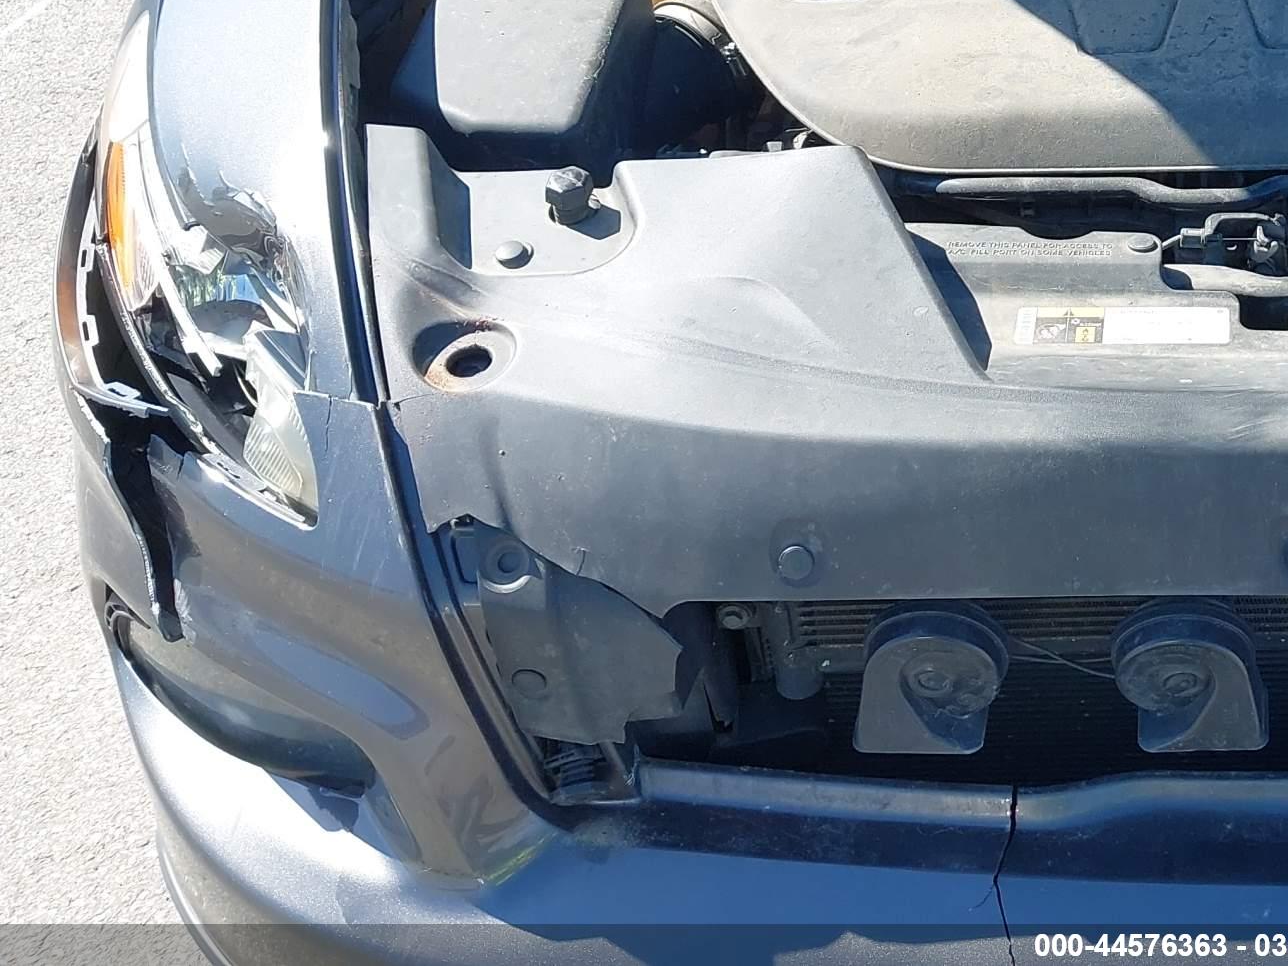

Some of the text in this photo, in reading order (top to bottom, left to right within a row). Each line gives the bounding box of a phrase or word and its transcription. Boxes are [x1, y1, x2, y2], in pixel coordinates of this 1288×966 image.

[1011, 241, 1041, 249] PANEL
[1101, 242, 1114, 250] TO
[1037, 249, 1065, 257] SOME
